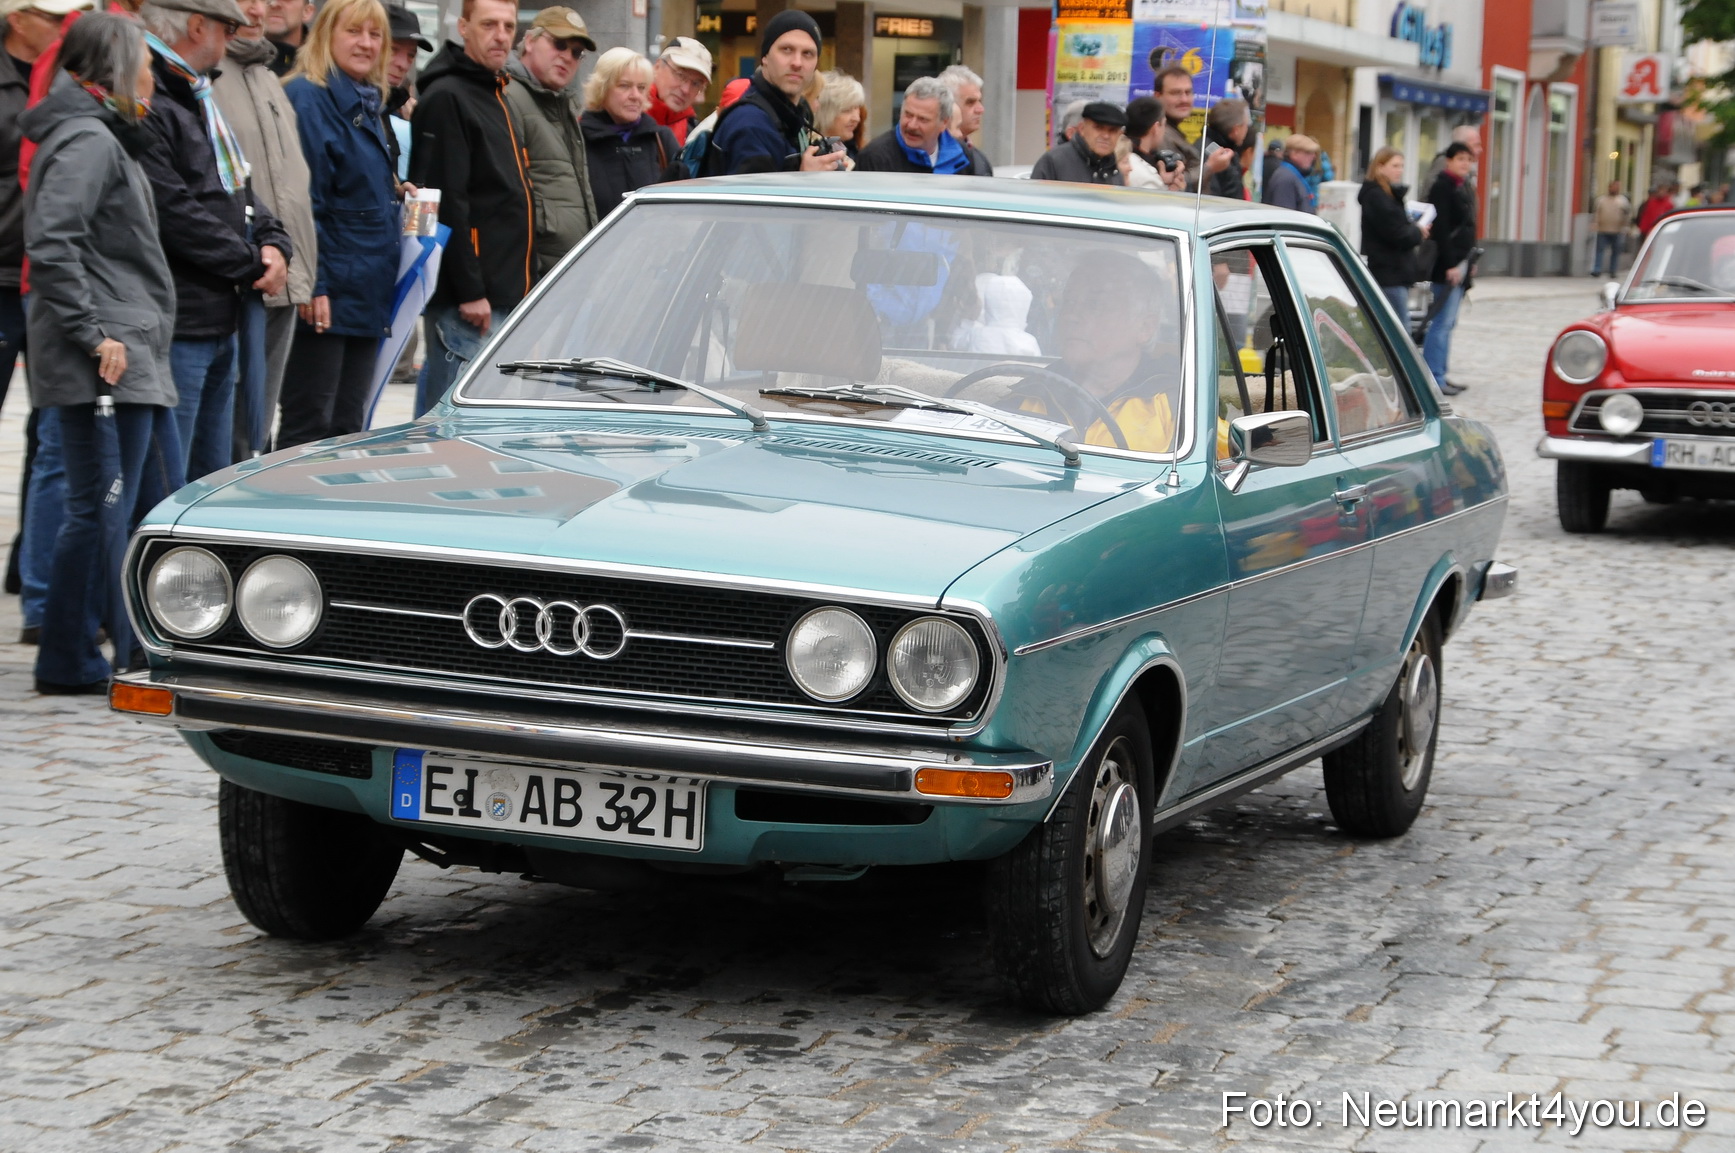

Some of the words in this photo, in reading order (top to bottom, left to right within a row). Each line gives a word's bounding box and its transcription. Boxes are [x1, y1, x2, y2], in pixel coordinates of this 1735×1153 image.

[877, 17, 933, 36] FRIES
[1107, 72, 1128, 81] 2013
[1667, 443, 1696, 464] RH
[402, 793, 412, 808] D
[425, 765, 481, 818] EI
[519, 775, 583, 828] AB
[596, 781, 696, 841] 32H
